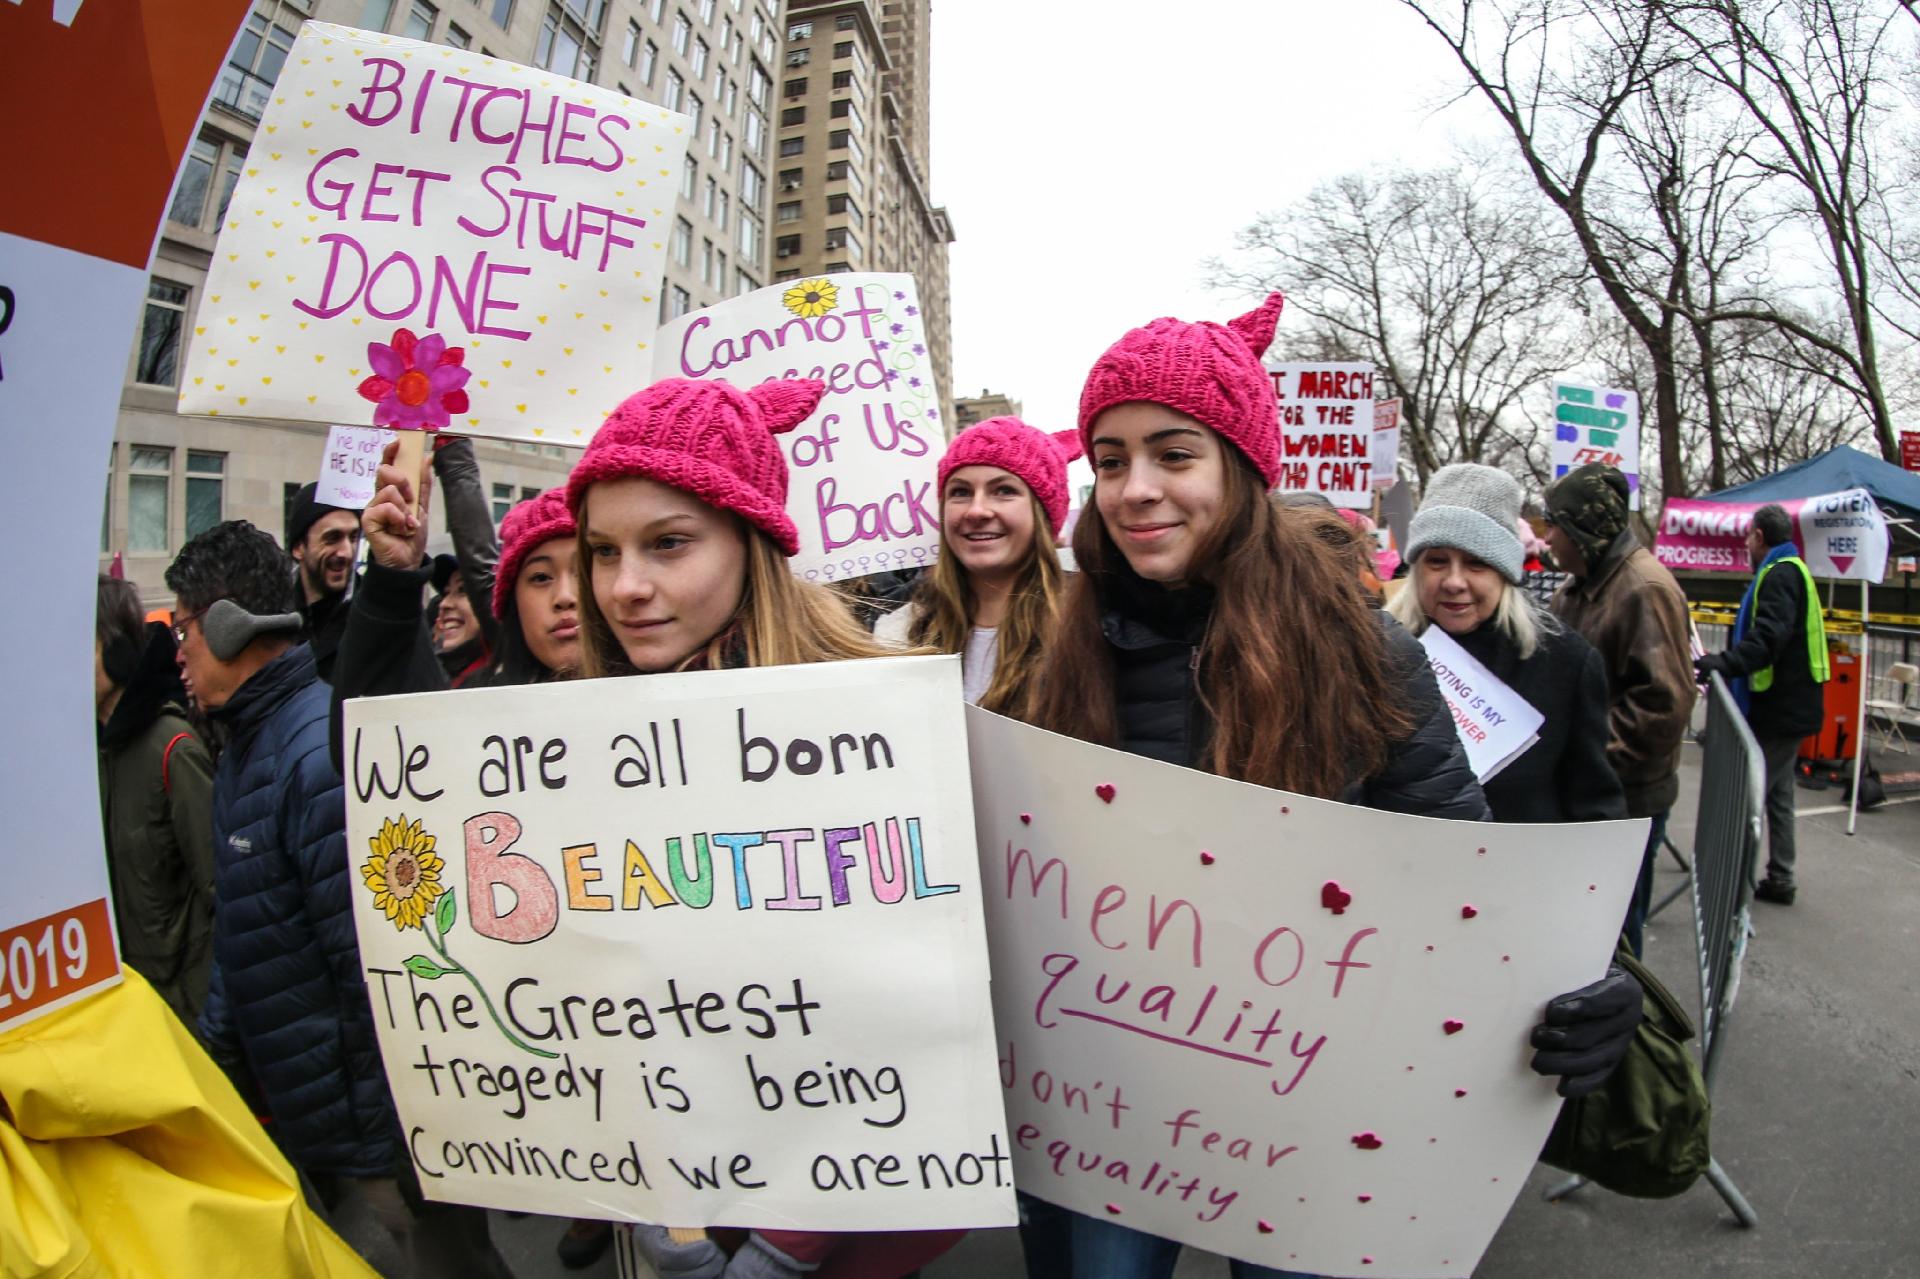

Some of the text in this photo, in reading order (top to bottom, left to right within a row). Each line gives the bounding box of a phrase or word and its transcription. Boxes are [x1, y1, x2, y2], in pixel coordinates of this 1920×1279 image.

[345, 57, 630, 172] BITCHES
[306, 147, 646, 272] GET STUFF
[292, 233, 532, 341] DONE
[680, 286, 882, 377] Cannot
[1297, 370, 1373, 400] MARCH
[1316, 405, 1354, 425] THE
[792, 403, 929, 467] of Us
[1283, 434, 1368, 457] WOMEN
[816, 477, 941, 554] Back
[1665, 508, 1753, 536] DONAT
[1828, 536, 1857, 553] HERE
[1654, 544, 1734, 566] PROGRESS
[1430, 658, 1506, 727] VOTING IS MY
[353, 706, 895, 804] We are all born
[463, 810, 962, 945] BEAUTIFUL
[367, 966, 821, 1042] The Greatest
[1034, 953, 1328, 1096] quality
[413, 1043, 907, 1128] tragedy is being
[1000, 1041, 1298, 1167] don't fear
[409, 1125, 1012, 1191] Convinced we are not.
[1016, 1122, 1239, 1222] equality
